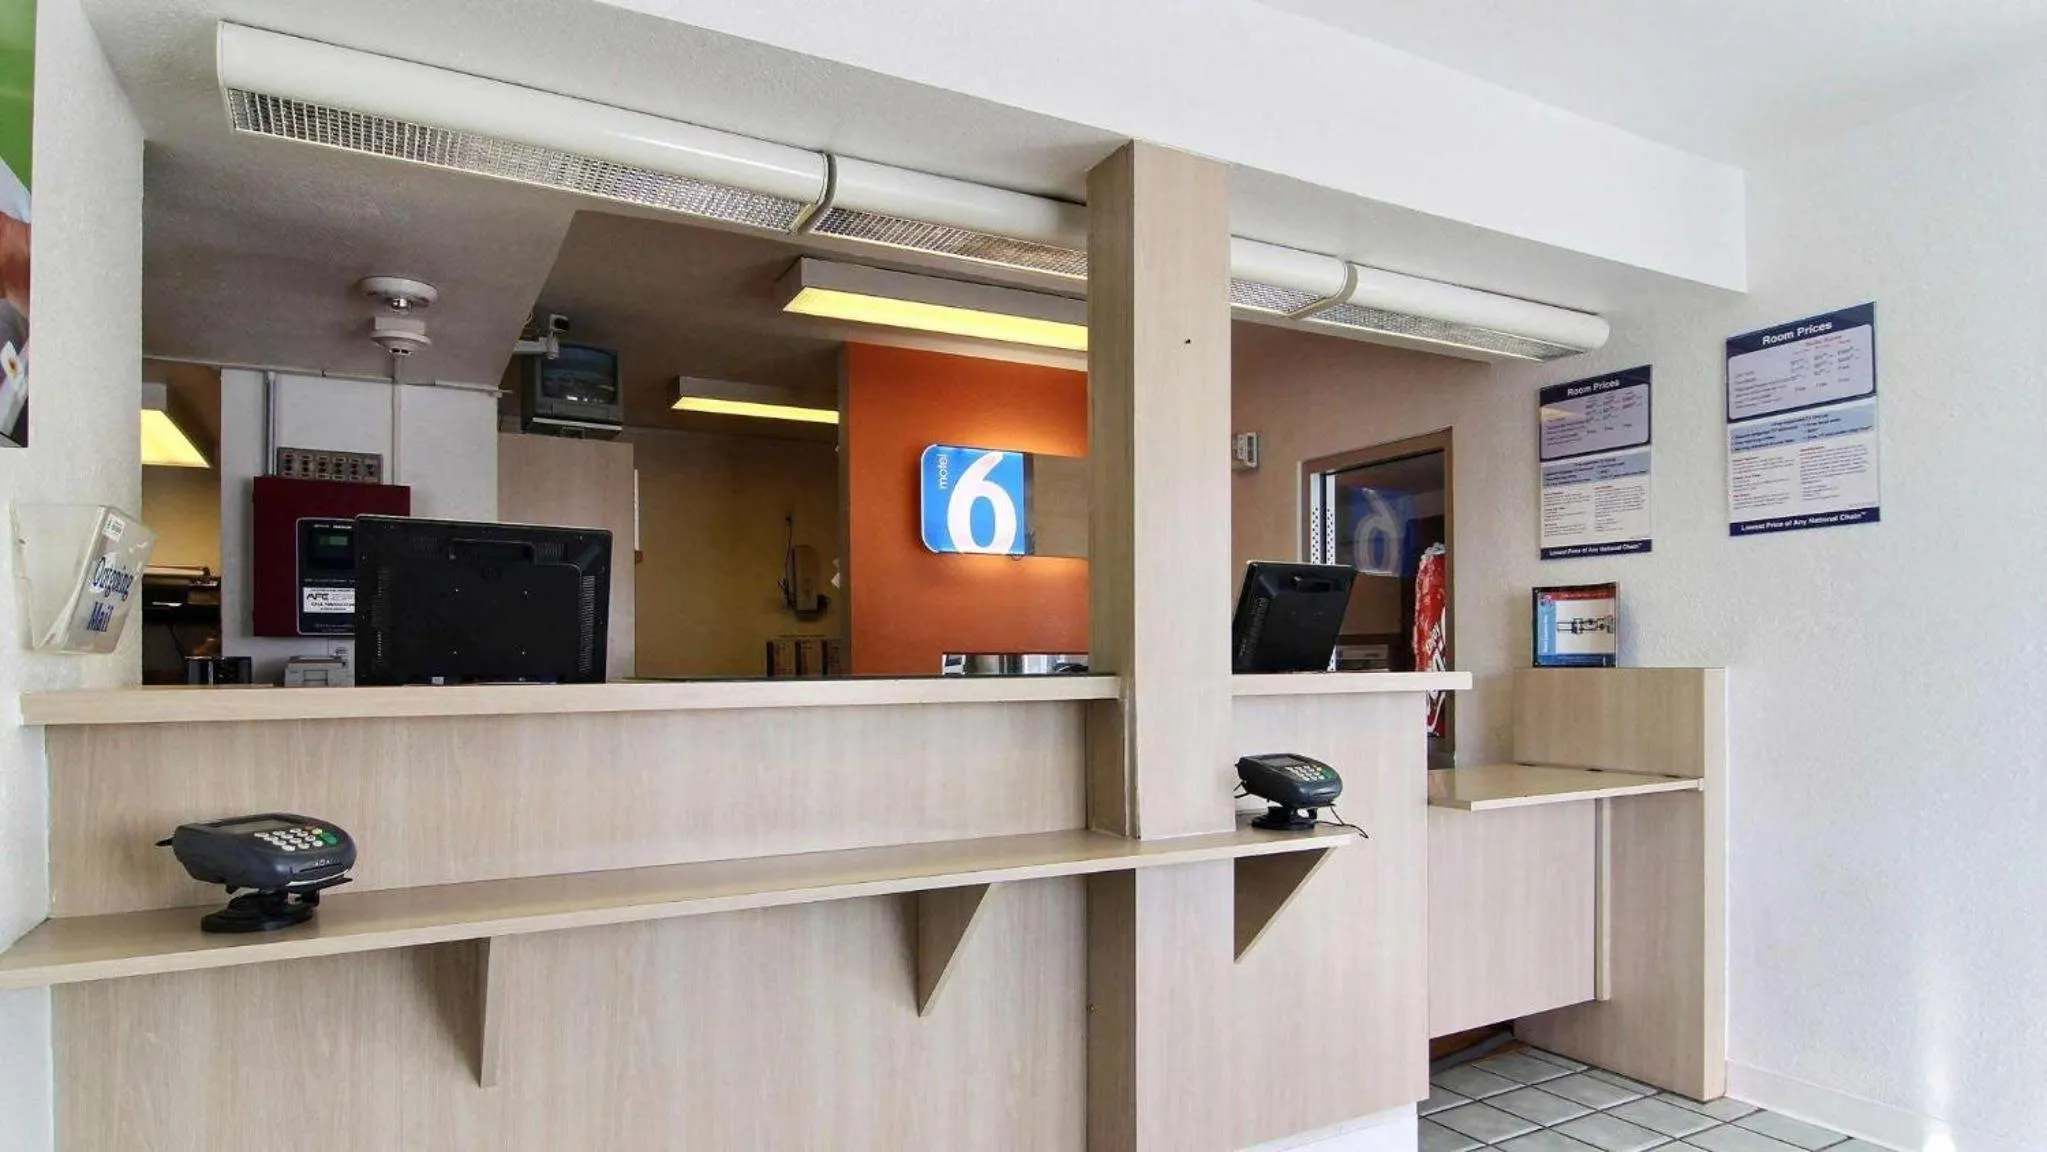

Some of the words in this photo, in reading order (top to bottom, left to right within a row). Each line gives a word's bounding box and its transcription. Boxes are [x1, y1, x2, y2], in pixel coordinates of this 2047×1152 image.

[1762, 331, 1794, 345] Room
[1797, 322, 1833, 337] Prices
[1567, 385, 1592, 397] Room
[1593, 379, 1620, 391] Prices
[936, 453, 949, 490] motel
[946, 451, 1018, 555] 6
[1766, 521, 1784, 529] Price
[1793, 519, 1807, 527] Any
[1808, 515, 1839, 524] National
[86, 601, 115, 632] Mail
